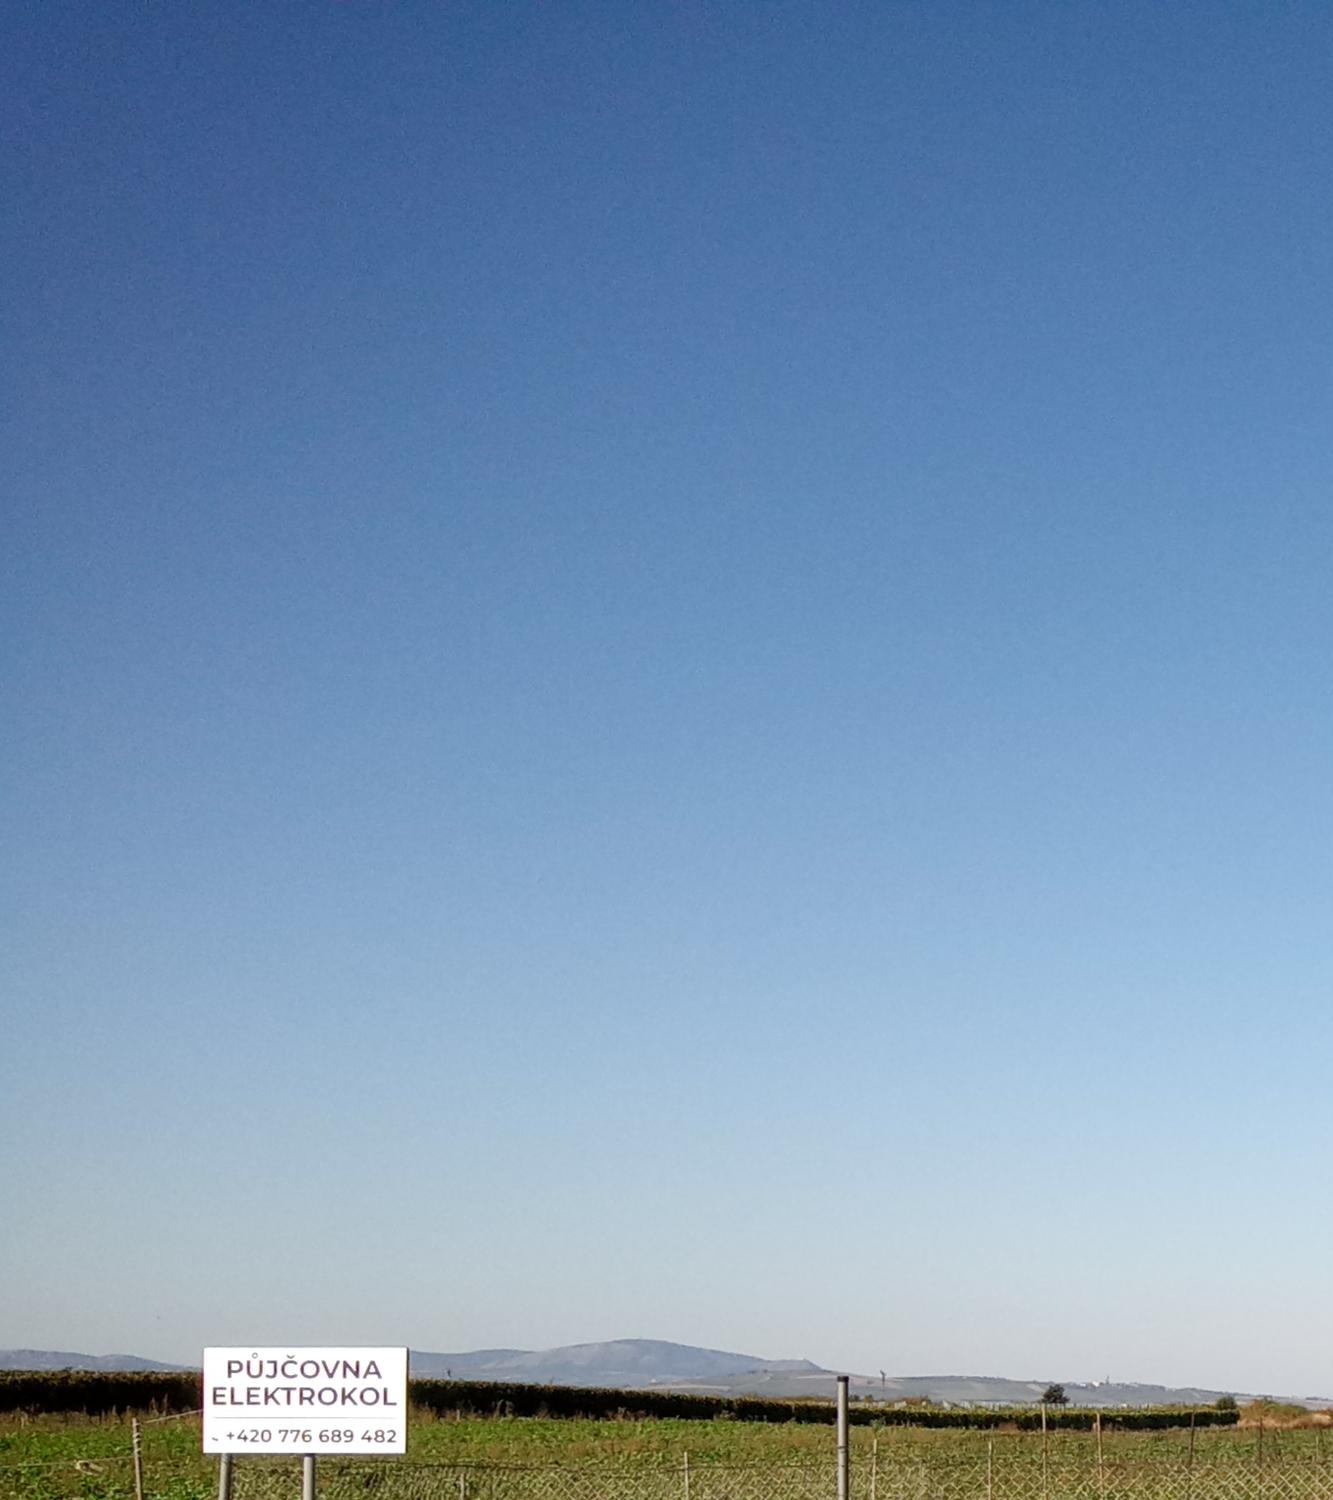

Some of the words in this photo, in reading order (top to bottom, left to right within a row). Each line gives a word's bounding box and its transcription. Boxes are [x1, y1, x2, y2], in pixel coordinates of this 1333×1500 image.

[227, 1352, 382, 1379] PŮJČOVNA
[212, 1387, 397, 1406] ELEKTROKOL
[226, 1429, 272, 1443] +420
[278, 1429, 312, 1443] 776
[318, 1429, 354, 1443] 689
[361, 1429, 397, 1443] 482
